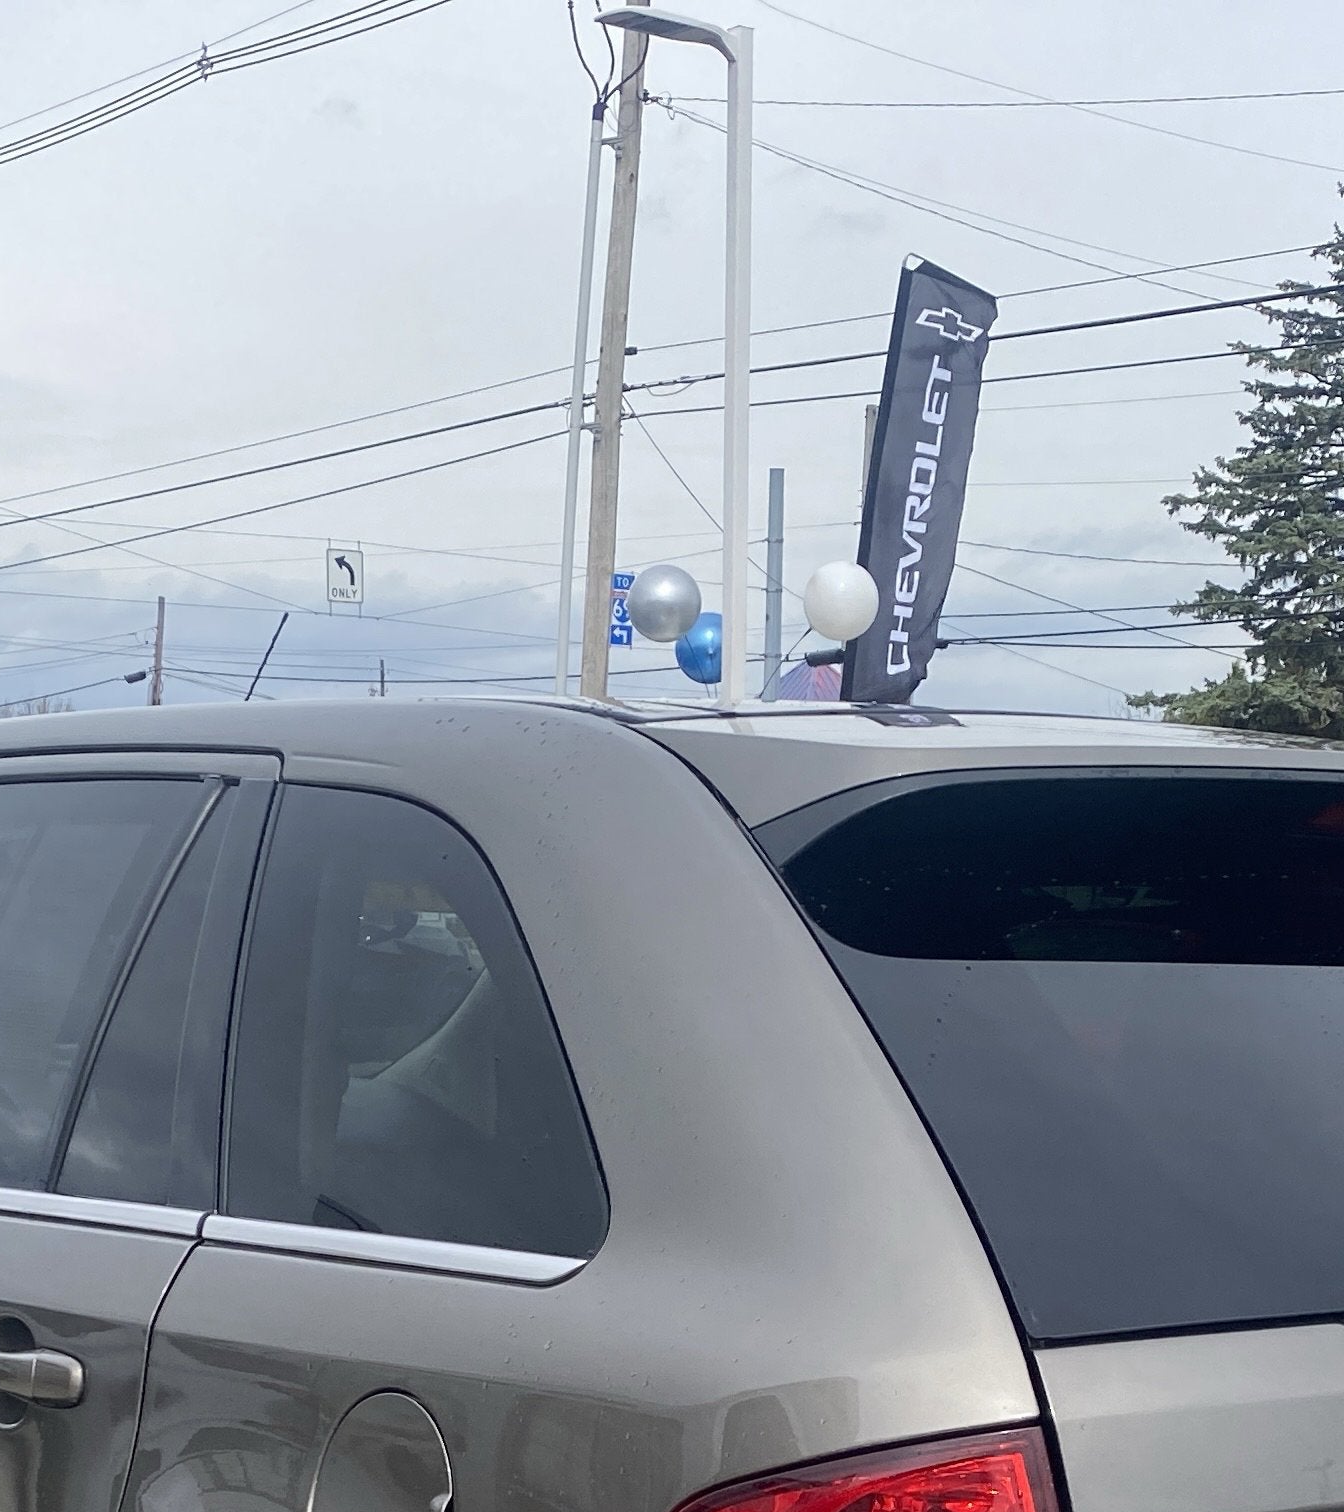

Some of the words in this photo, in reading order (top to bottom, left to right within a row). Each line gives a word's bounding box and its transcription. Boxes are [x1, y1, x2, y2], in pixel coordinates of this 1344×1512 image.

[886, 354, 952, 676] CHEVROLET
[616, 576, 630, 588] TO
[331, 587, 358, 599] ONLY
